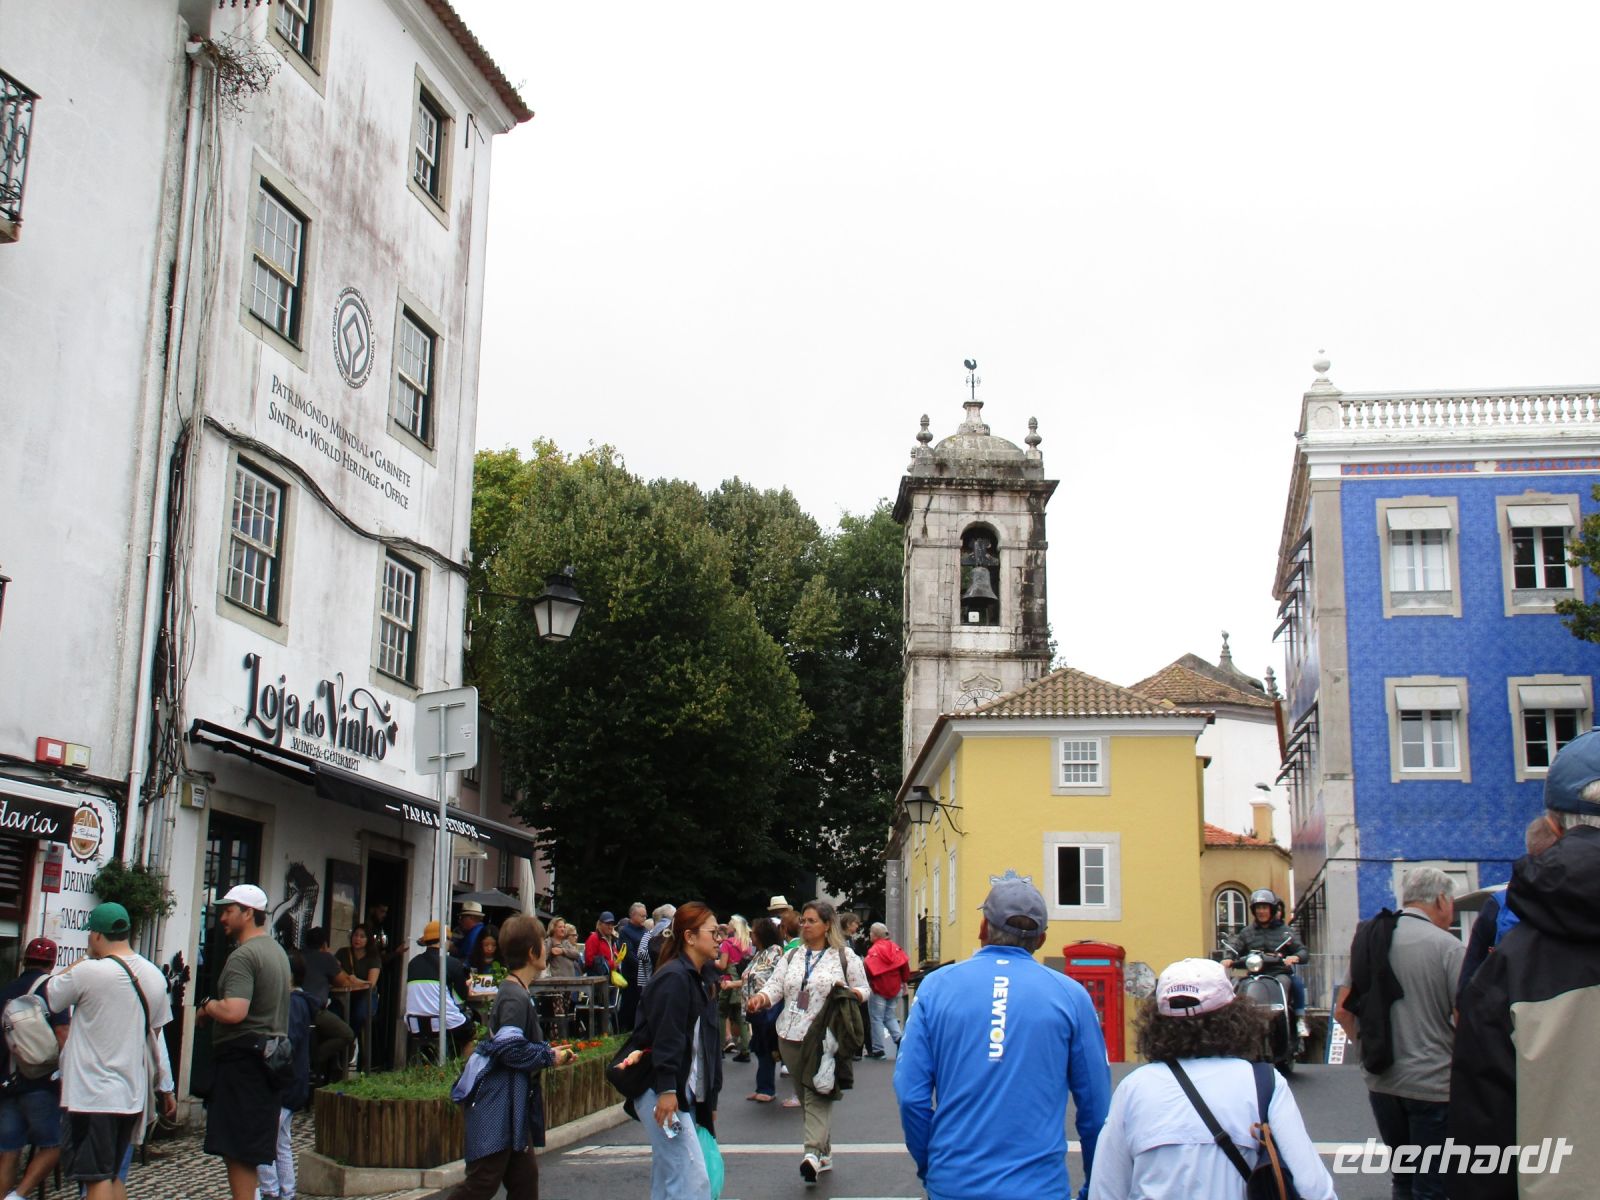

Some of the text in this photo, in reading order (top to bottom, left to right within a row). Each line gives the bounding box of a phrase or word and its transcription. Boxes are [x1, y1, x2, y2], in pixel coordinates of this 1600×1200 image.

[268, 401, 409, 510] SINTRA WORLD HERITAGE OFFICE
[243, 653, 392, 761] Loja do Vinho
[402, 804, 433, 825] TAPAS
[63, 870, 97, 894] DRINKS
